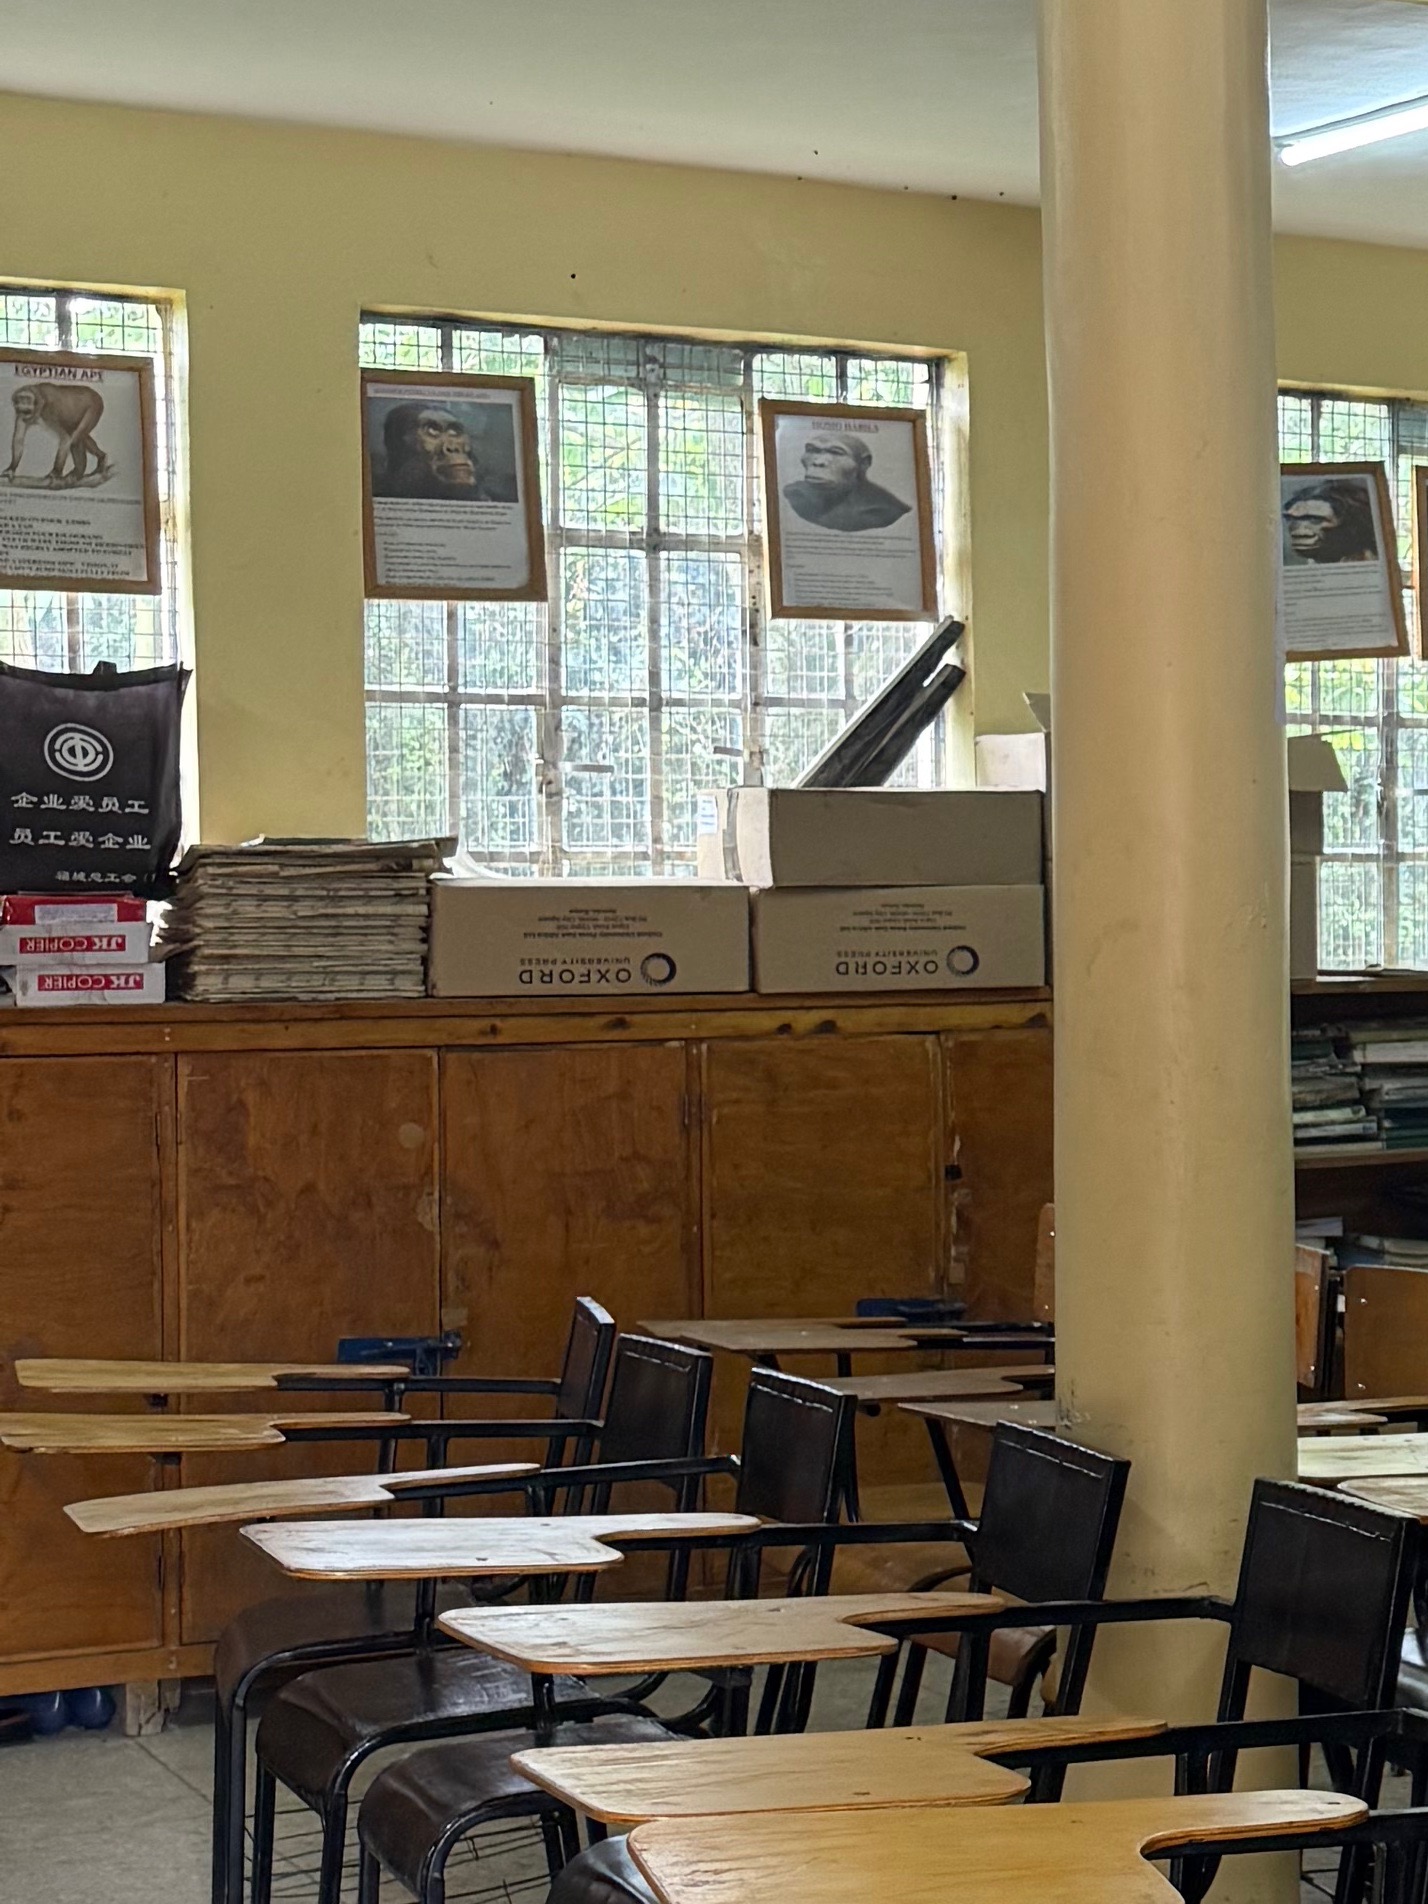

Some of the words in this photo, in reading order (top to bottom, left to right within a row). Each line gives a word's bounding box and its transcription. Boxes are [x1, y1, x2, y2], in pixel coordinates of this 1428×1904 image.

[15, 364, 77, 380] EGYPTIAN
[10, 791, 150, 815] 企业爱员工
[9, 827, 151, 850] 员工爱企业
[26, 937, 88, 952] COPIER
[91, 936, 123, 950] JK
[519, 957, 557, 966] PRESS
[560, 957, 631, 966] UNIVERSITY
[835, 960, 939, 976] OXFORD
[44, 976, 106, 990] COPIER
[110, 975, 142, 988] JK
[518, 968, 632, 985] OXFORD
